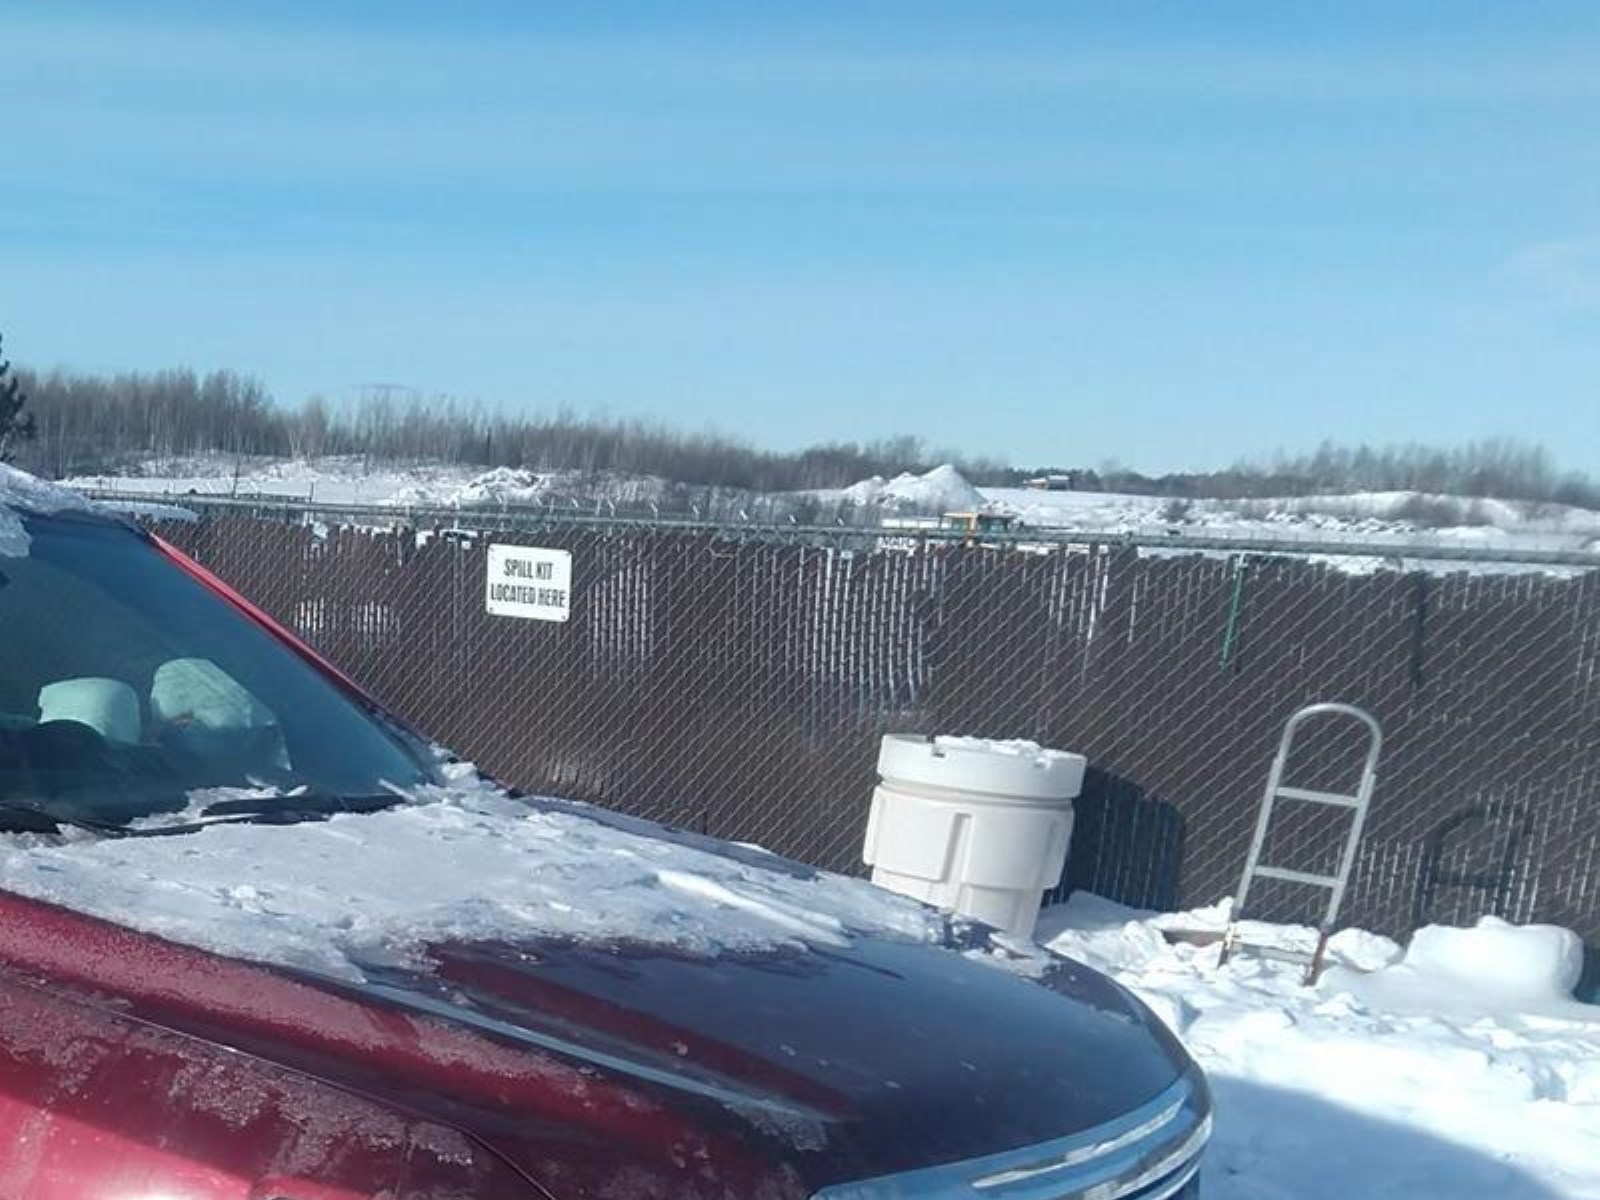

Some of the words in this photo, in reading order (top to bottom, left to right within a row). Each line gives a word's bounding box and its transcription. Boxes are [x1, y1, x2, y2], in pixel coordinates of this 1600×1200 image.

[504, 559, 533, 579] SPILL
[536, 562, 553, 580] KIT
[491, 583, 536, 604] LOCATED
[538, 587, 566, 608] HERE
